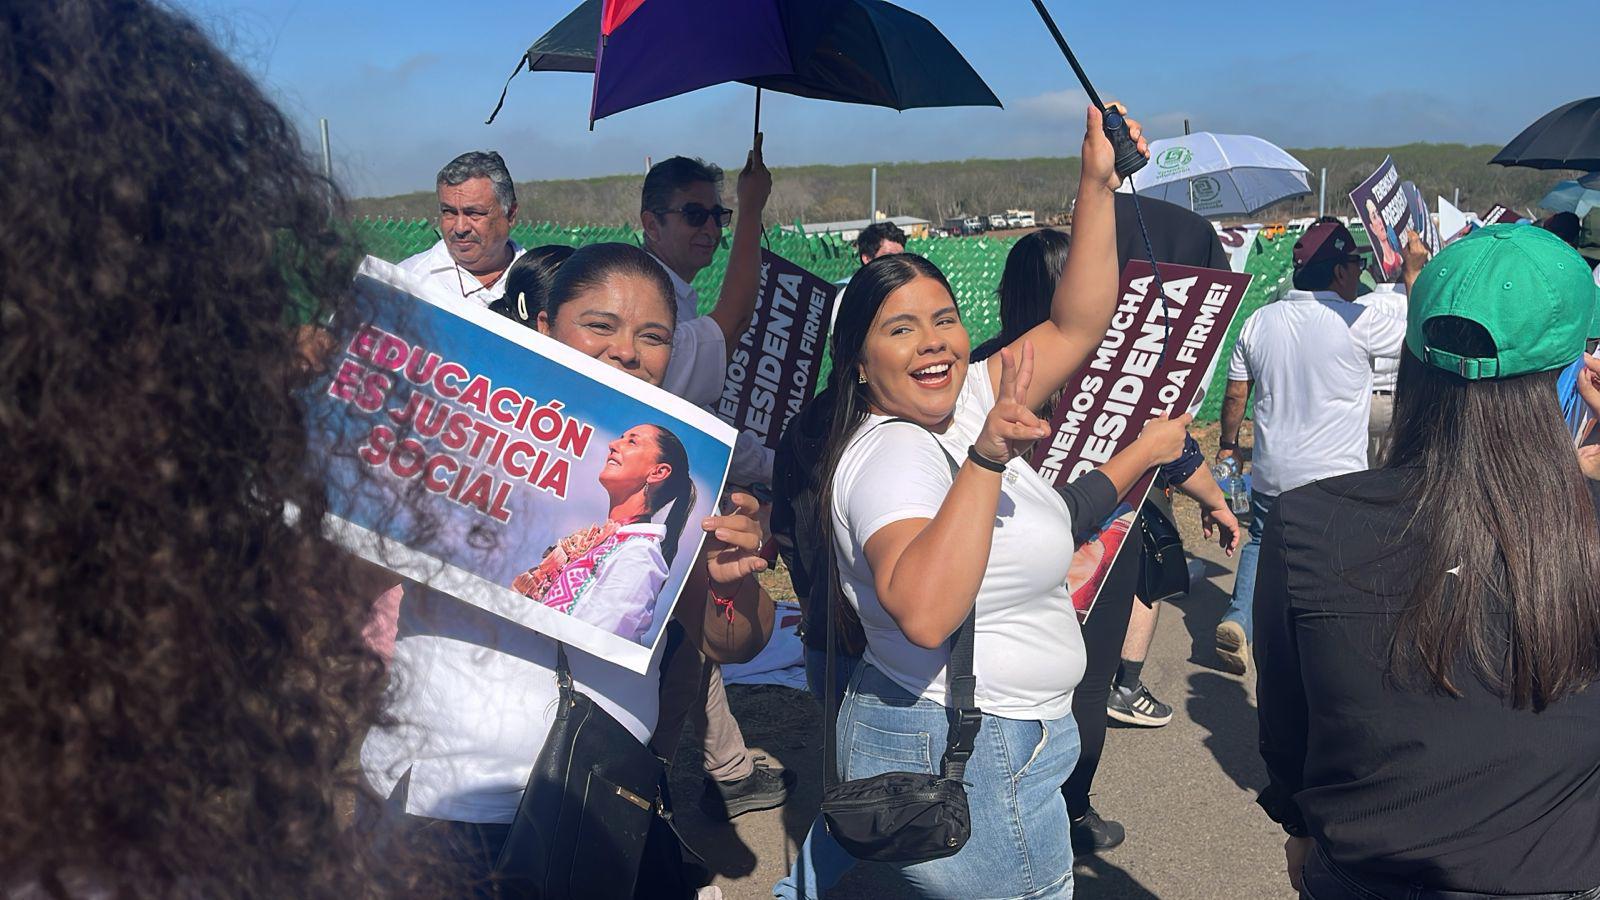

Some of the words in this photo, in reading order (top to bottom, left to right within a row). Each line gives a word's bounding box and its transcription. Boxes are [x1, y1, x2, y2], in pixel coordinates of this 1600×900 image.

[800, 286, 827, 356] FIRME!
[1090, 275, 1155, 372] MUCHA
[1175, 282, 1233, 364] FIRME!
[328, 358, 392, 413] ES
[387, 390, 571, 500] JUSTICIA
[346, 323, 595, 460] EDUCACIÓN
[358, 425, 513, 525] SOCIAL
